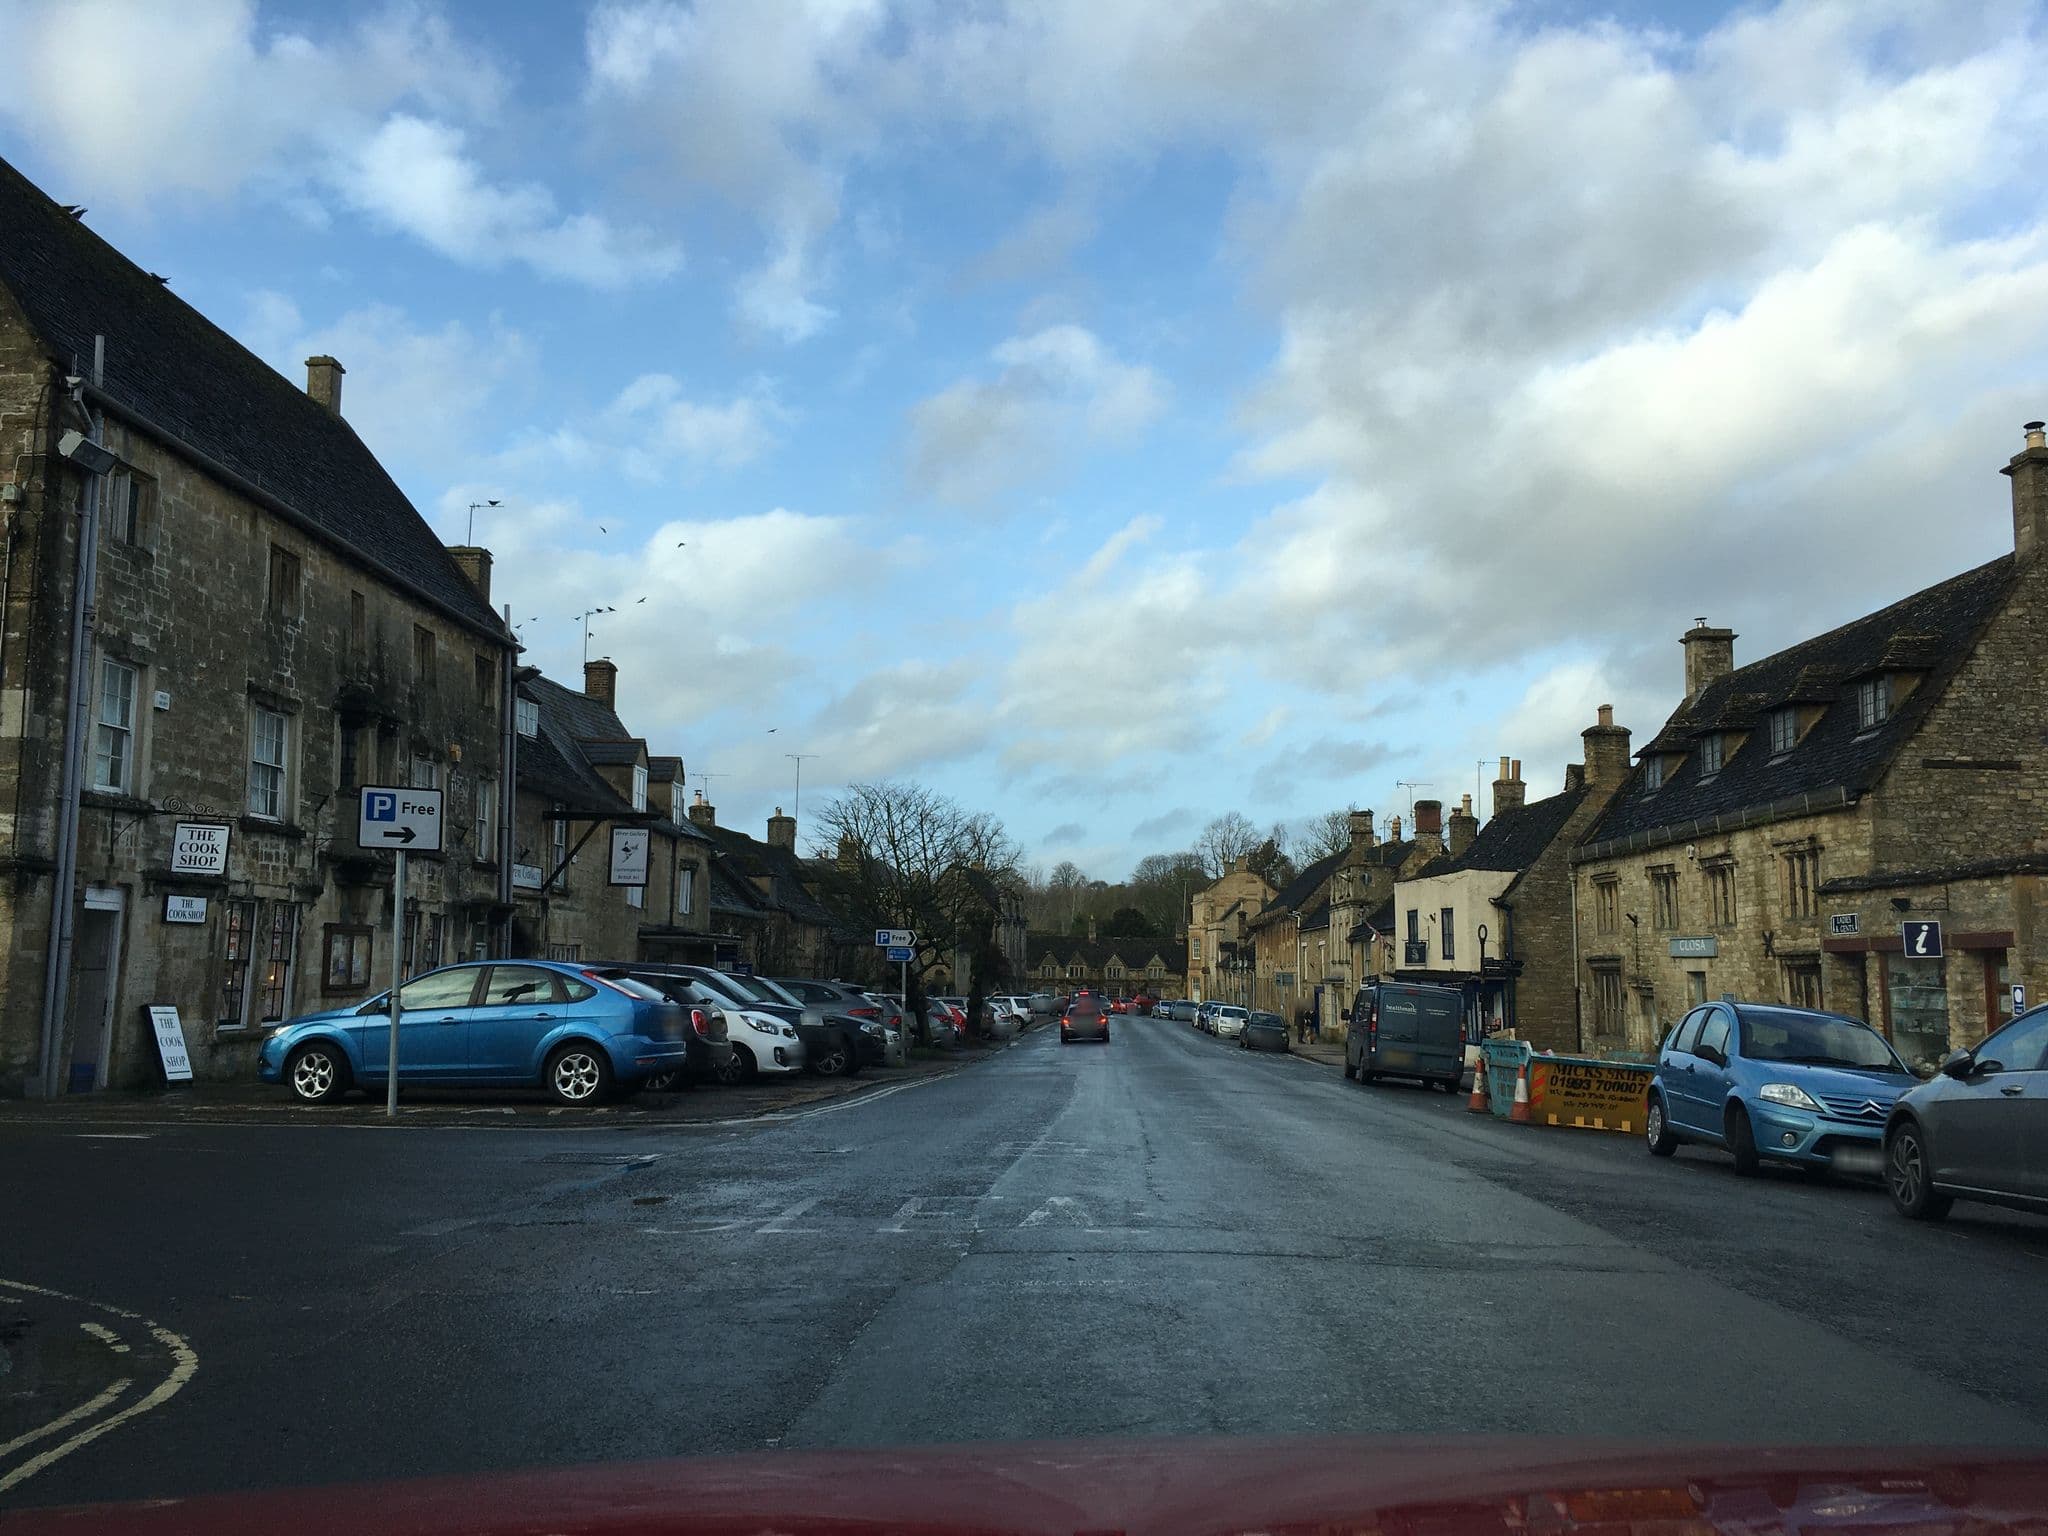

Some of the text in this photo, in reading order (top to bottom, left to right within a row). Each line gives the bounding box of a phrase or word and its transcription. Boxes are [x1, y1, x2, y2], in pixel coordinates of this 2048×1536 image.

[373, 796, 435, 819] P Free
[188, 830, 216, 841] THE
[180, 842, 220, 854] COOK
[180, 855, 217, 867] SHOP
[181, 899, 194, 909] THE
[169, 909, 204, 920] COOK SHOP
[881, 933, 889, 943] P
[160, 1018, 176, 1029] THE
[160, 1037, 183, 1048] COOK
[166, 1056, 186, 1068] SHOP
[1553, 1064, 1649, 1082] MICKS SKIPS
[1596, 1080, 1646, 1094] 700007
